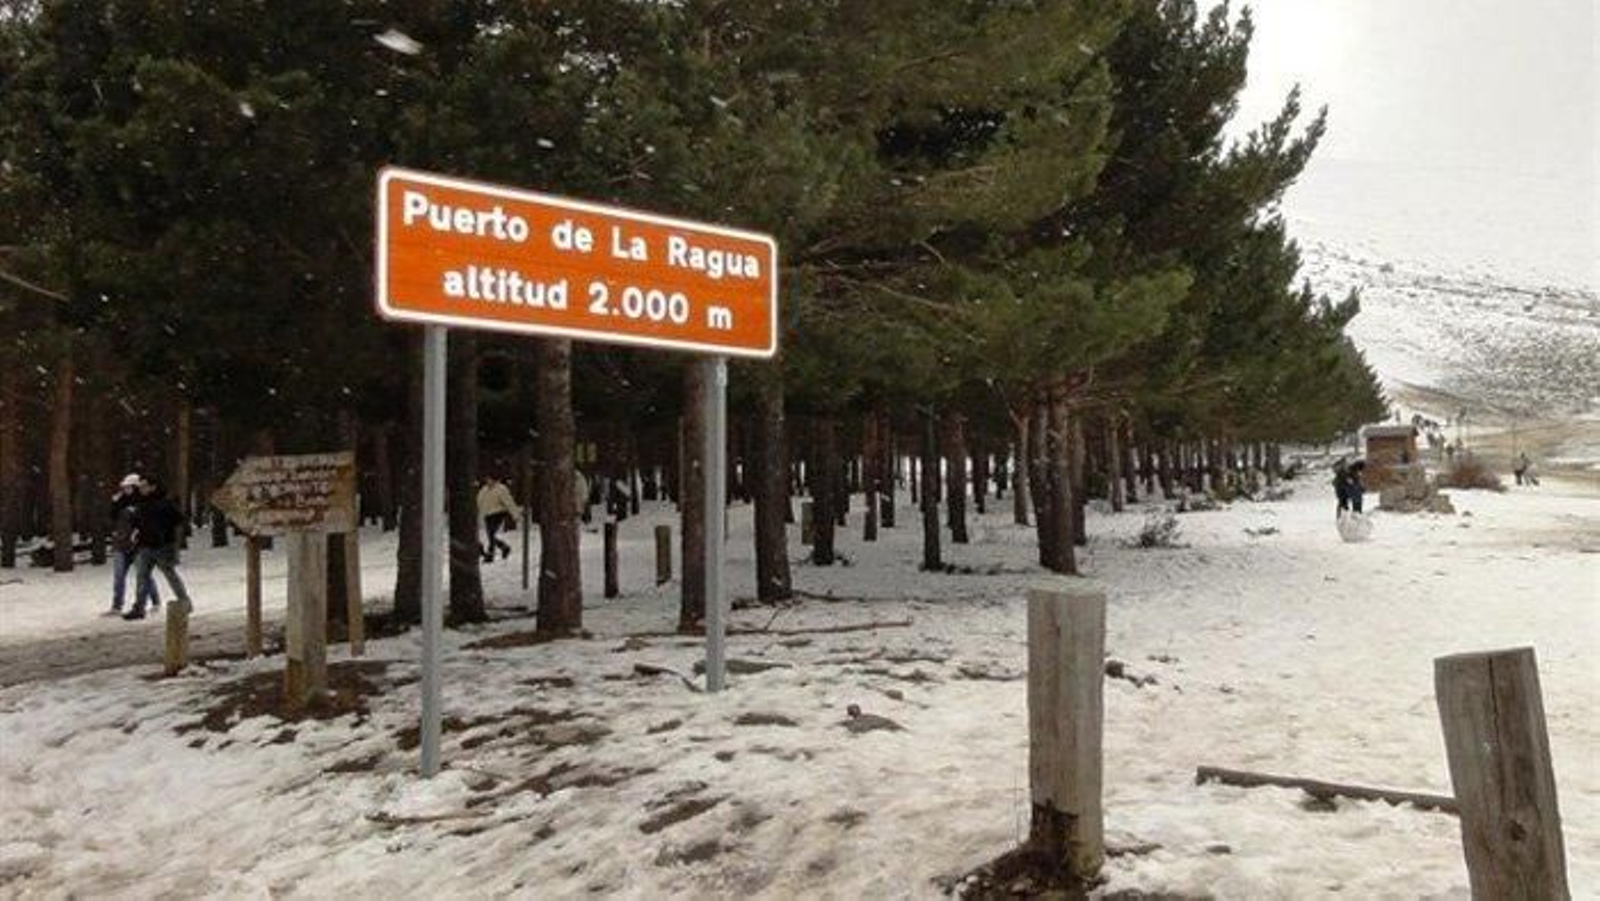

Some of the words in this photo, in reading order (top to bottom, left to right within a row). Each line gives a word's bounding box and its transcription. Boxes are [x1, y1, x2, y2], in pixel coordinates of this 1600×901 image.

[403, 190, 529, 242] Puerto
[552, 219, 594, 253] de
[612, 226, 648, 261] La
[668, 235, 760, 279] Ragua
[443, 265, 568, 309] altitud
[588, 281, 689, 324] 2.000
[707, 305, 732, 330] m
